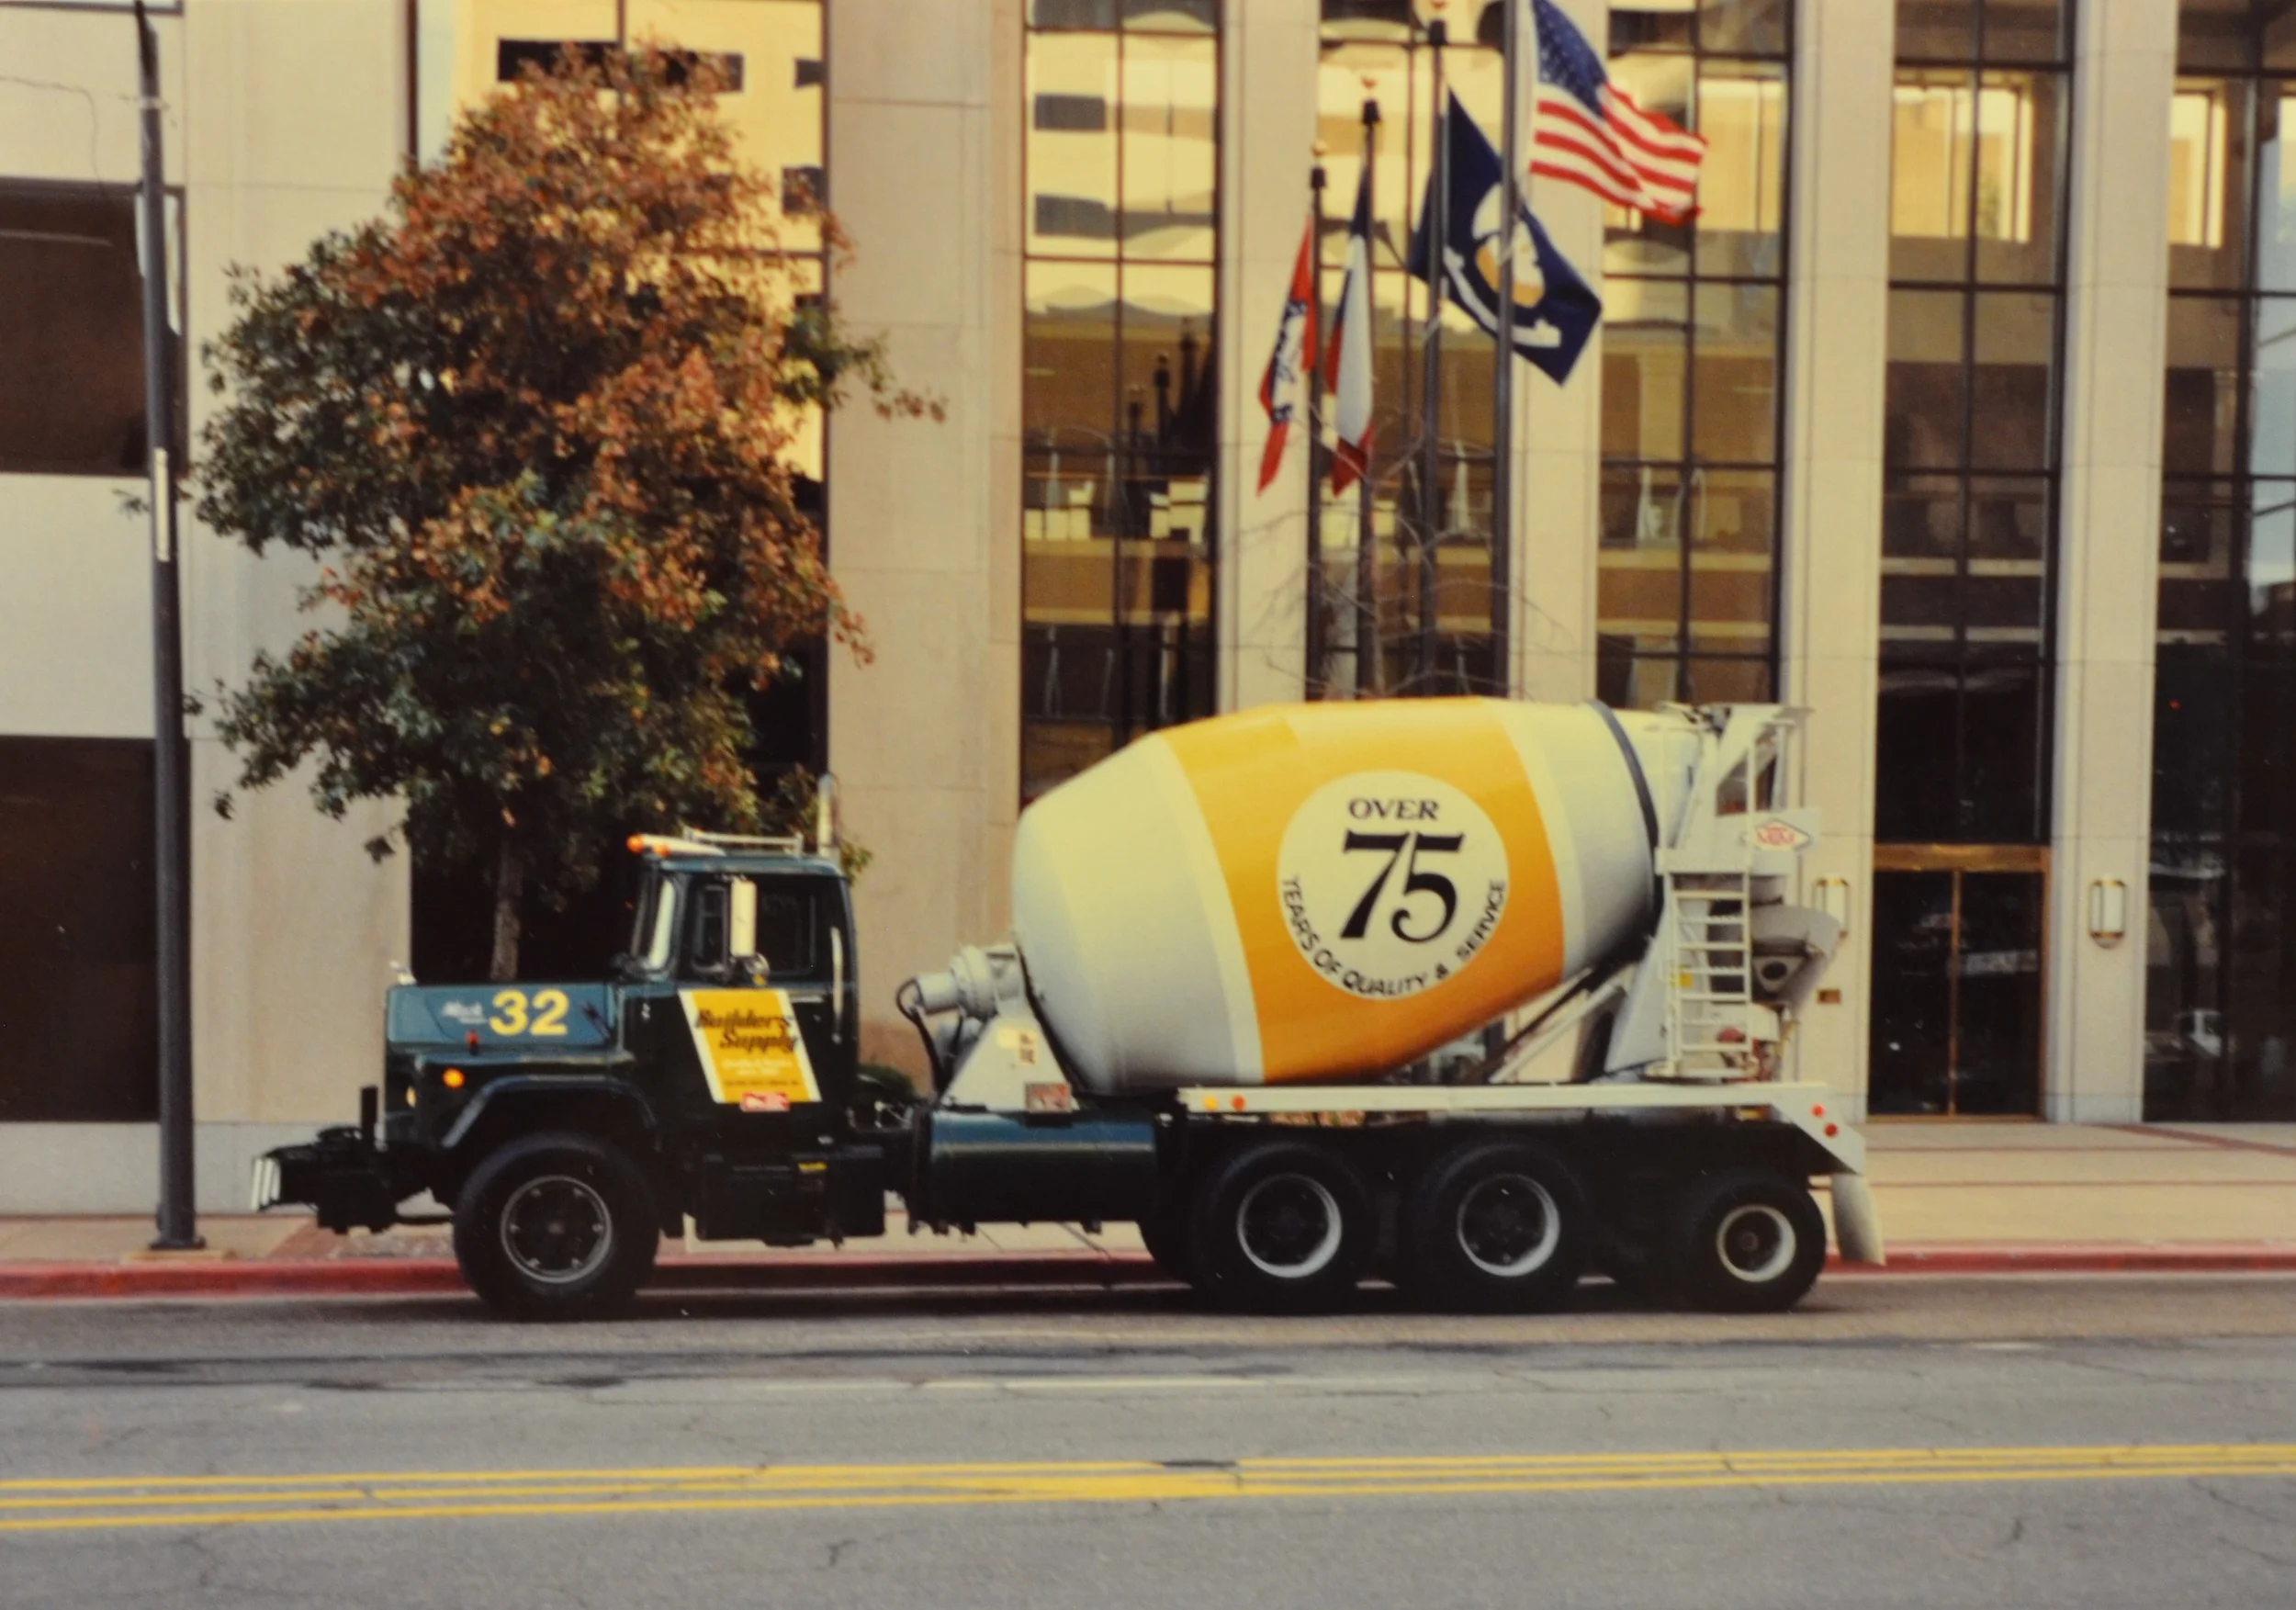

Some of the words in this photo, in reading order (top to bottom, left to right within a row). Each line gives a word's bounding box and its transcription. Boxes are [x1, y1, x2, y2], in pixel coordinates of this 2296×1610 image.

[1348, 797, 1440, 820] OVER
[1339, 828, 1465, 943] 75
[1282, 875, 1320, 951] YEARS
[1313, 949, 1342, 975] OF
[1342, 969, 1428, 996] QUALITY
[1435, 963, 1449, 980] &
[1456, 879, 1506, 963] SERVICE
[489, 989, 569, 1036] 32
[719, 1025, 798, 1053] Supply
